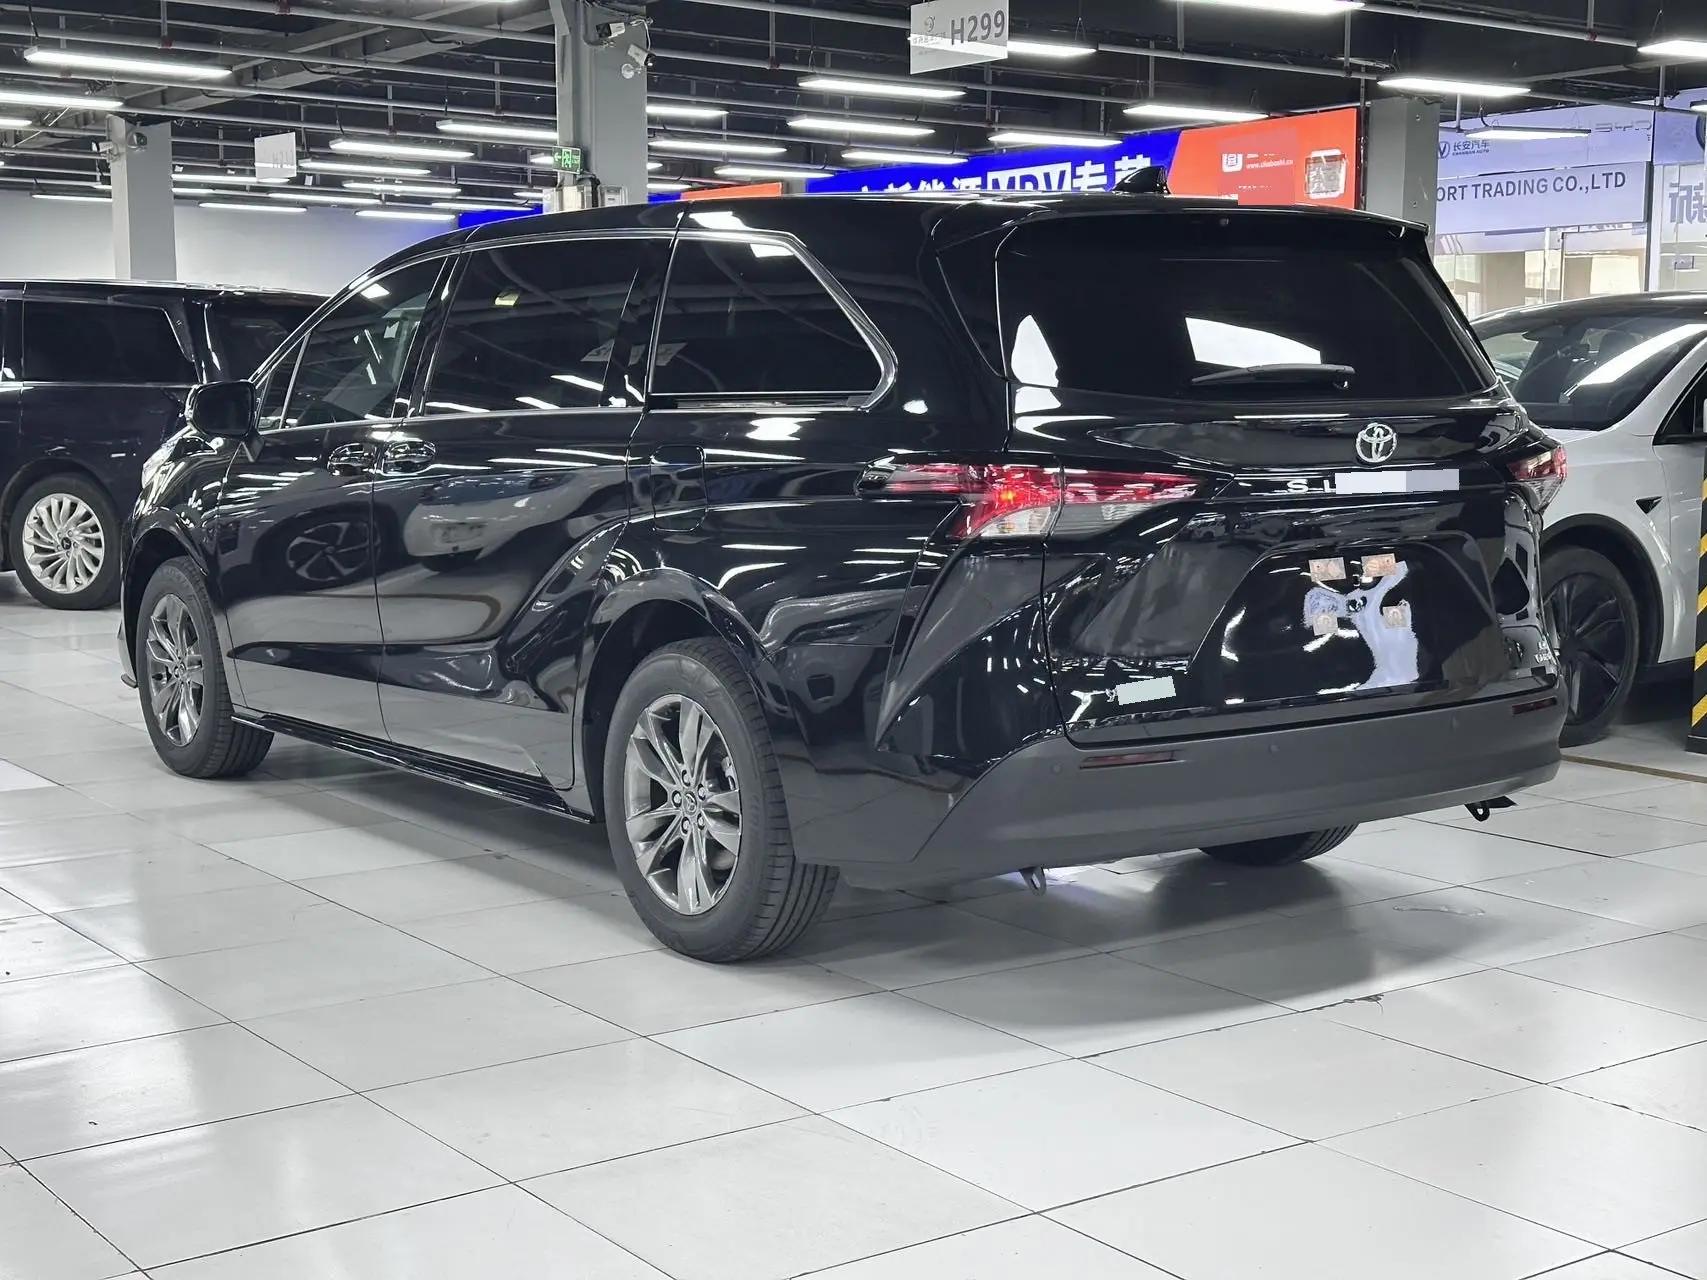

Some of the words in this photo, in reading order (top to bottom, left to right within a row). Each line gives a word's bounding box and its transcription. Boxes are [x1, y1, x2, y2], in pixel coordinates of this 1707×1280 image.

[951, 9, 1005, 46] H299
[1471, 177, 1548, 200] TRADING
[1552, 171, 1626, 195] CO.,LTD
